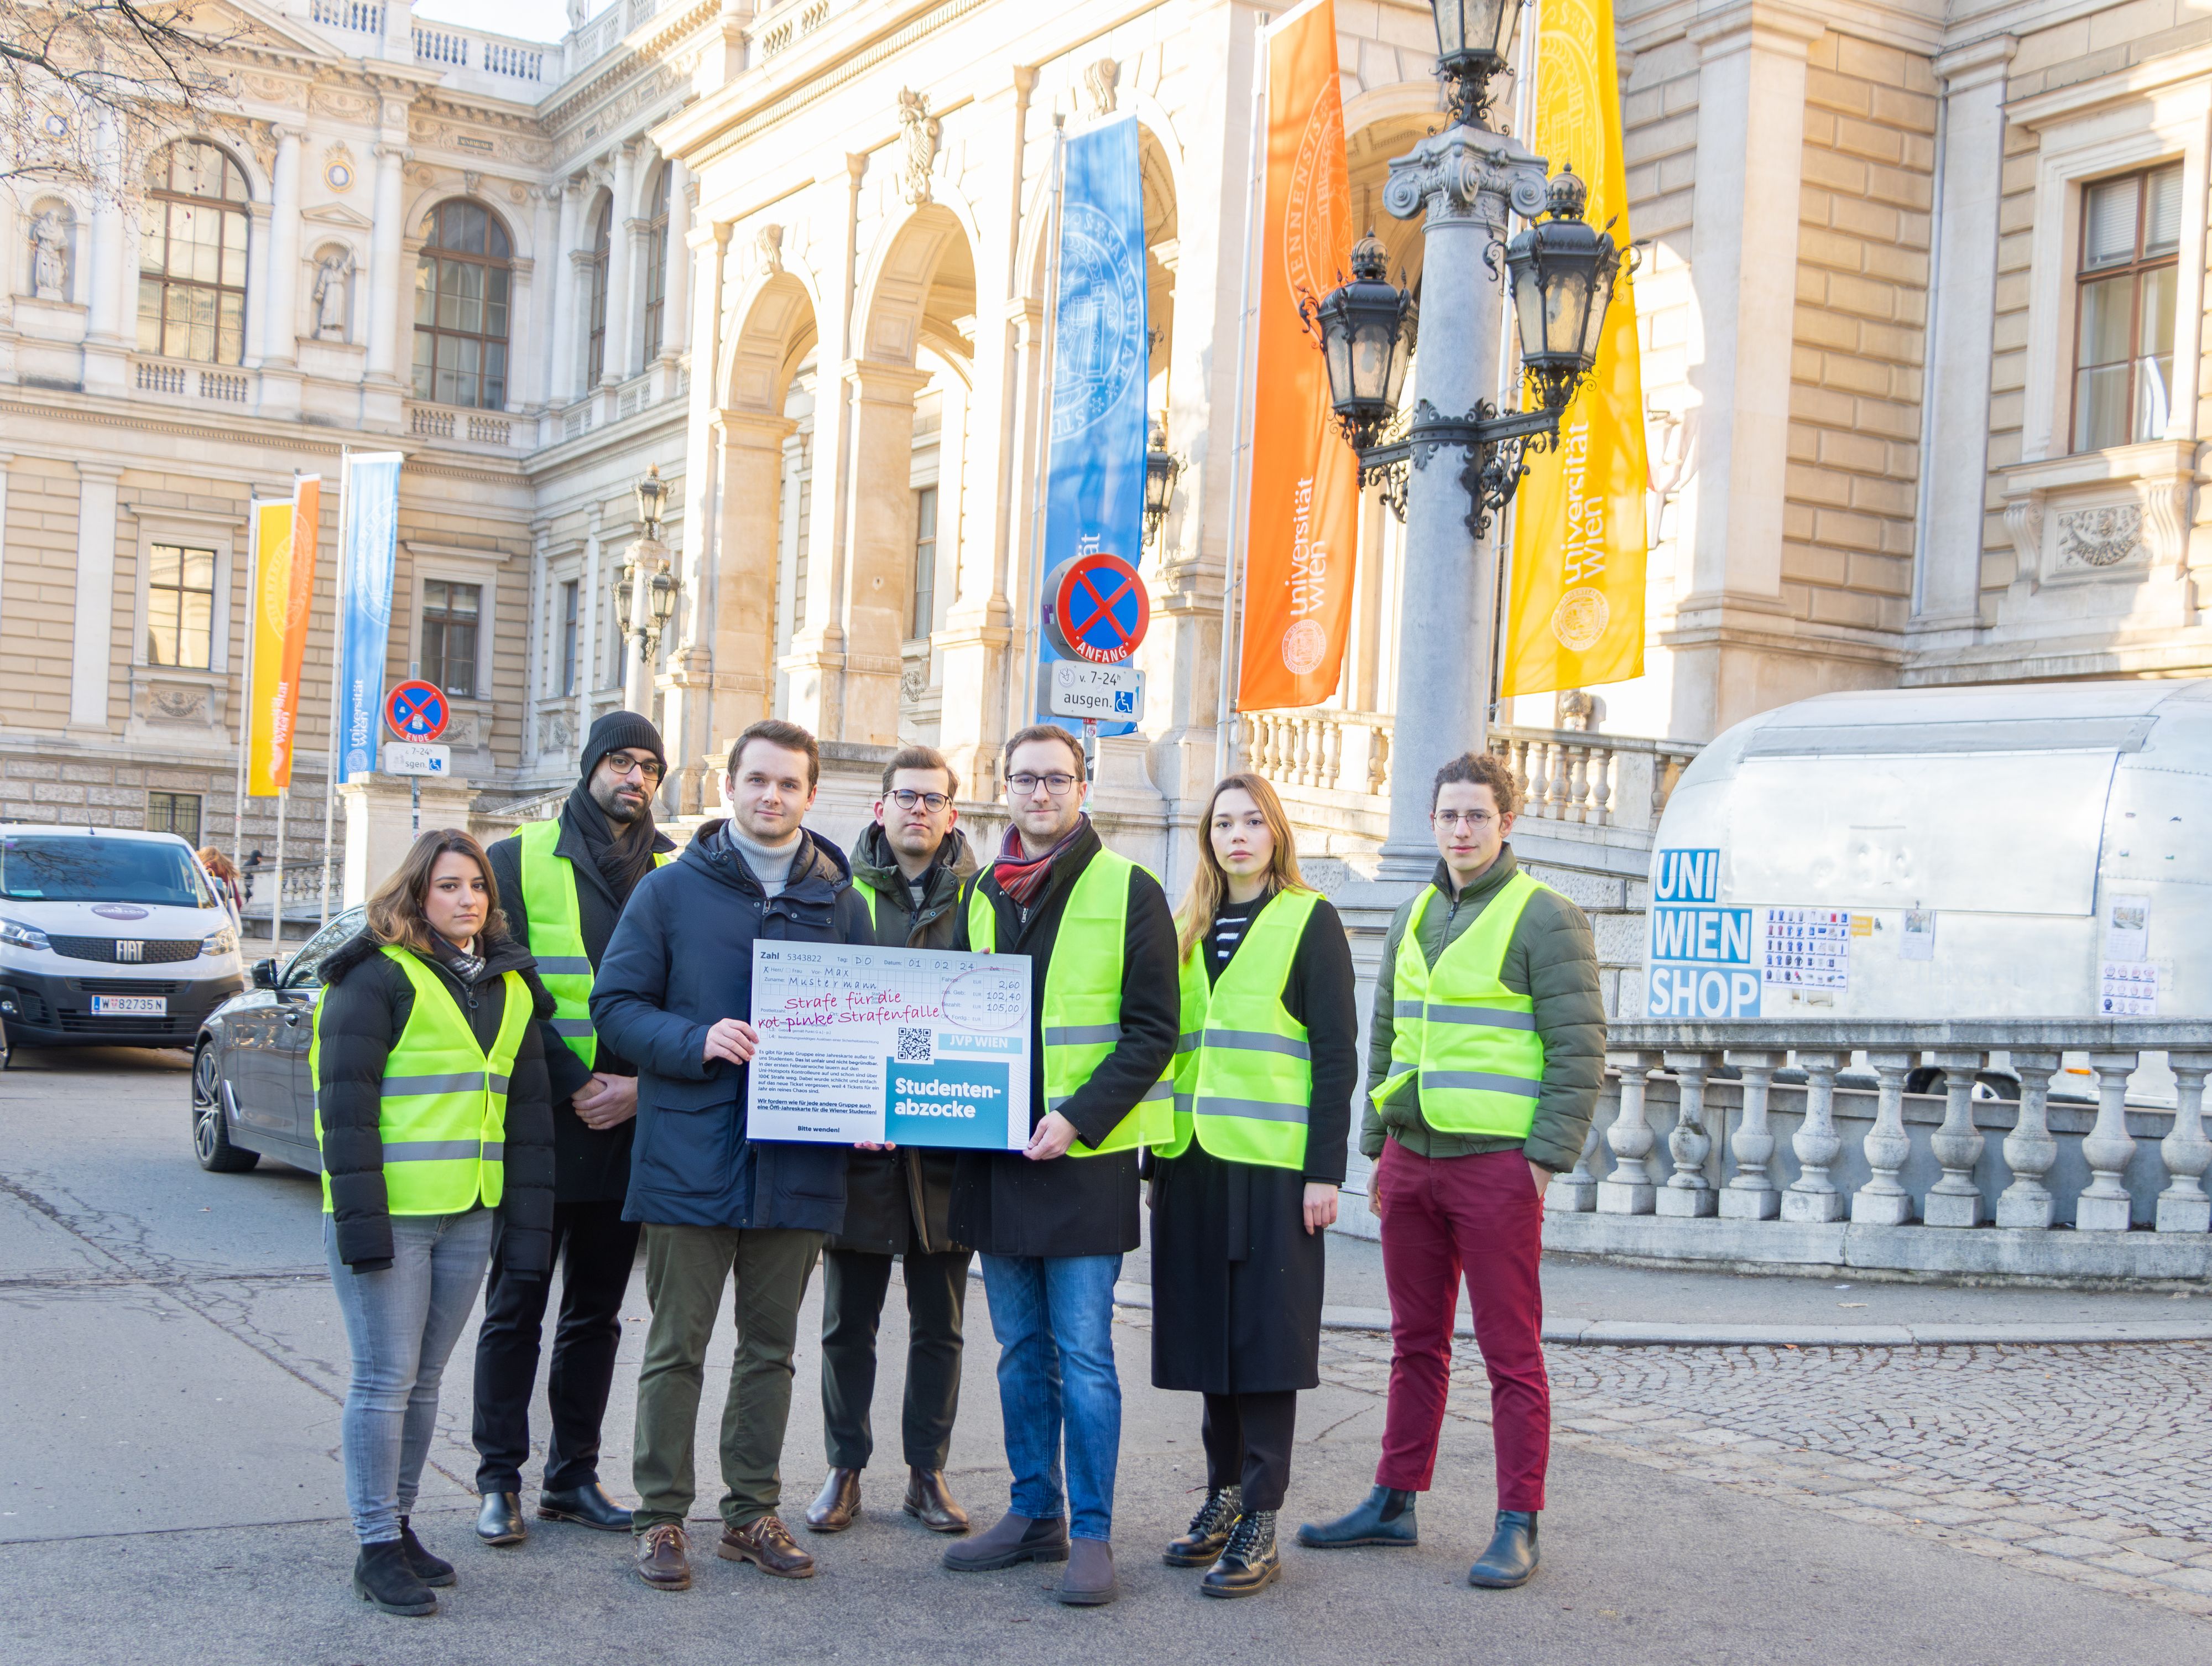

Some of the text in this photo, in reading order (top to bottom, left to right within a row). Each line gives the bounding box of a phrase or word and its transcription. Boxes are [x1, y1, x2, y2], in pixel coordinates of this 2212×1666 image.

[1105, 230, 1138, 383] SAPIENTIAE
[1560, 420, 1589, 585] universität
[1284, 474, 1313, 615] universität
[1308, 540, 1326, 612] wien
[1076, 642, 1127, 663] ANFANG
[1064, 693, 1112, 709] ausgen.
[349, 679, 364, 747] universität
[406, 732, 430, 742] ENDE
[1656, 852, 1717, 899] UNI
[1655, 911, 1749, 960] WIEN
[116, 940, 144, 961] FIAT
[760, 951, 779, 960] Zahl
[787, 953, 822, 962] 5343822
[909, 959, 921, 967] 01
[960, 962, 974, 971] 24
[825, 967, 849, 977] Max
[789, 977, 877, 989] Mustermann
[999, 981, 1020, 990] 2,60
[1650, 968, 1758, 1017] SHOP
[102, 998, 109, 1008] W
[846, 991, 873, 1010] für
[879, 988, 901, 1004] die
[987, 992, 1021, 1002] 102,40
[987, 1003, 1019, 1013] 105,00
[758, 1011, 833, 1032] rot-pinke
[950, 1035, 1008, 1048] JVP WIEN
[895, 1077, 1001, 1098] Studenten-
[894, 1098, 976, 1118] abzocke
